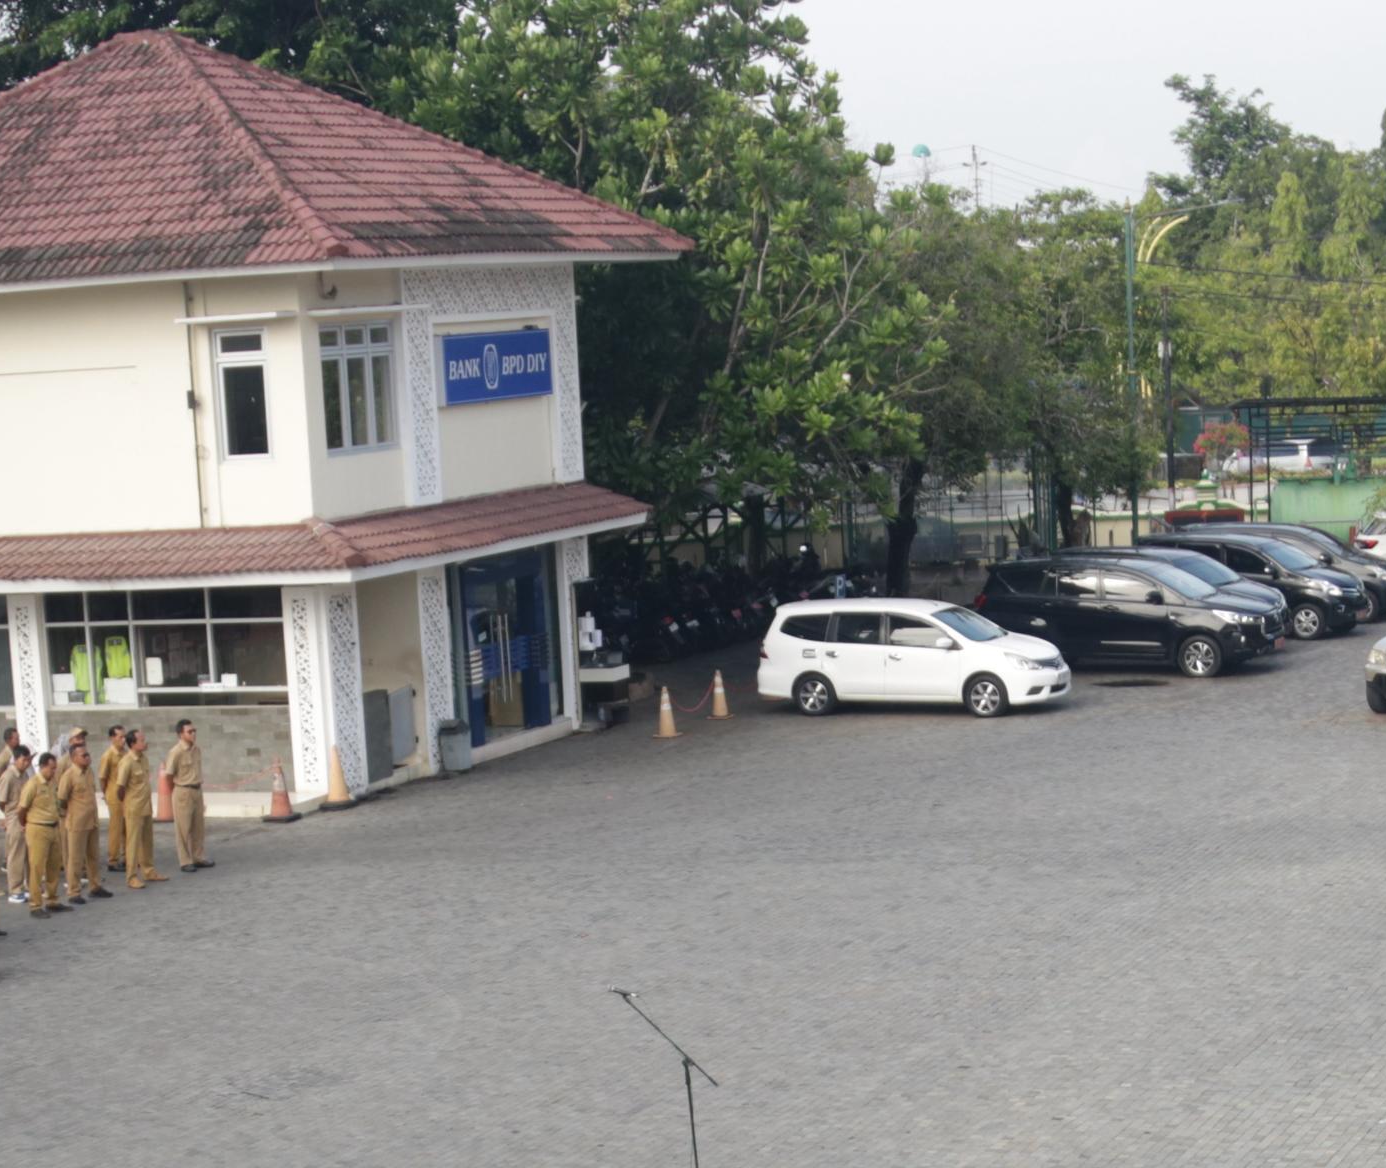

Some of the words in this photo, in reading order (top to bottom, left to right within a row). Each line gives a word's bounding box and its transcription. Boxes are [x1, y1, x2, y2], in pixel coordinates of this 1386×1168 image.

[448, 357, 481, 380] BANK
[502, 354, 525, 375] BPD
[526, 352, 548, 373] DIY
